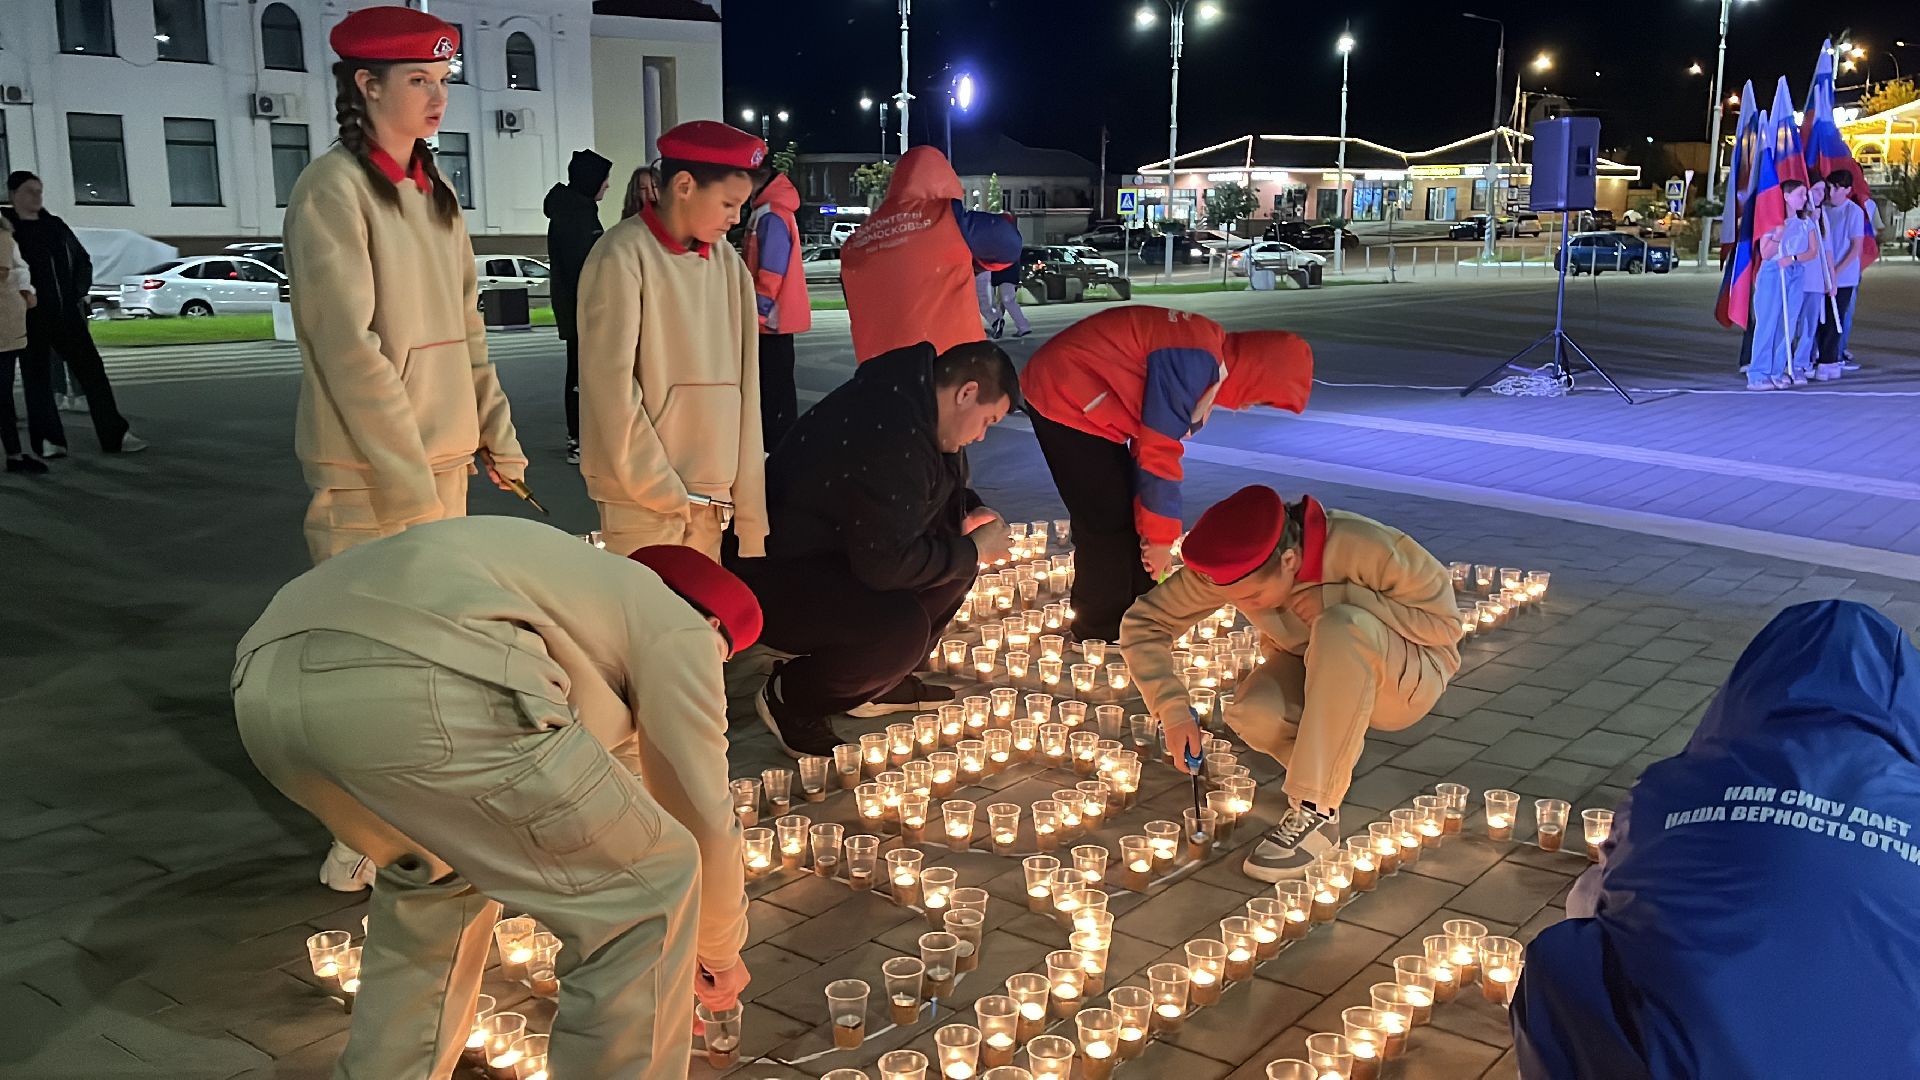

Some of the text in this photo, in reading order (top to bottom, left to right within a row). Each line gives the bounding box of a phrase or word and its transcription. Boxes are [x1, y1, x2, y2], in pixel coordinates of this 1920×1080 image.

[1664, 806, 1726, 830] НАША
[1730, 806, 1856, 841] ВЕРНОСТЬ
[1724, 786, 1912, 837] НАМ СИЛУ ДАЕТ
